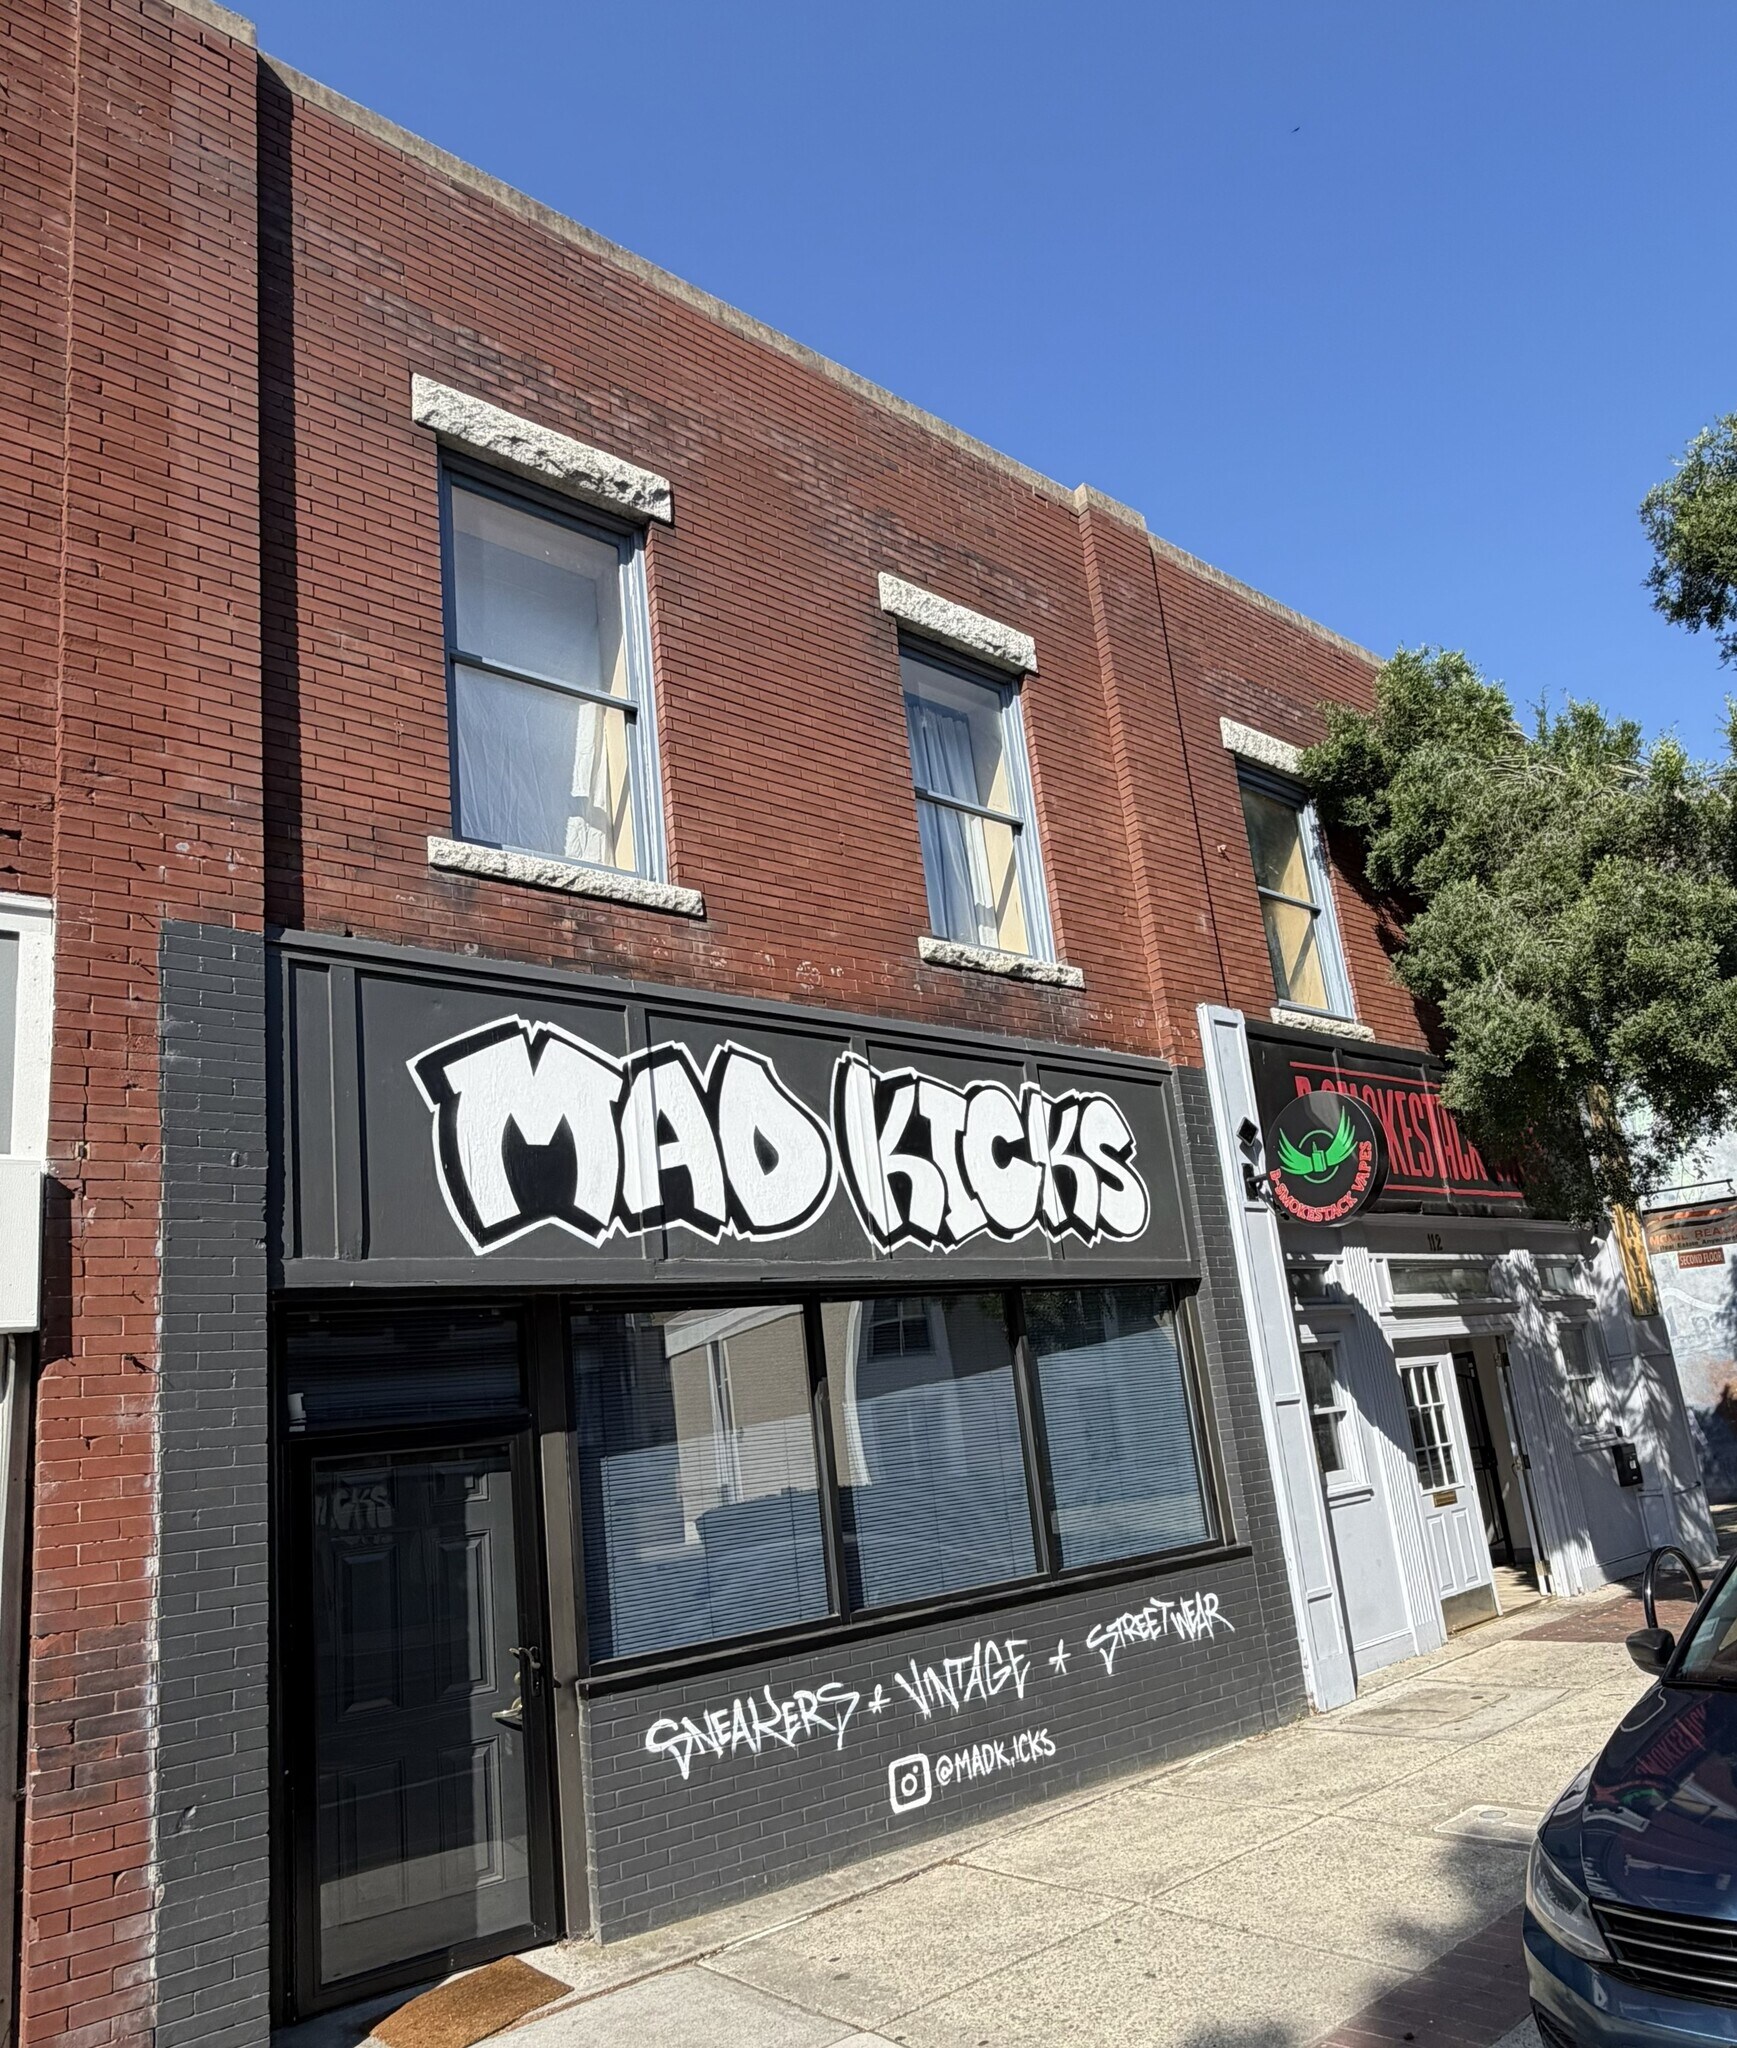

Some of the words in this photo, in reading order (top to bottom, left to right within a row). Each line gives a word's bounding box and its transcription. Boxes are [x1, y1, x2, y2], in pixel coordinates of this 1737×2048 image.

[406, 1014, 838, 1255] MAD
[831, 1051, 1150, 1254] KICKS
[1269, 1168, 1358, 1222] B-SMOKESTACK
[1351, 1140, 1373, 1192] VAPES
[1427, 1233, 1443, 1251] 112
[1680, 1253, 1703, 1266] SECOND
[1703, 1251, 1724, 1264] FLOOR
[645, 1682, 859, 1779] SNEAKERS
[895, 1639, 1031, 1720] VINTAGE
